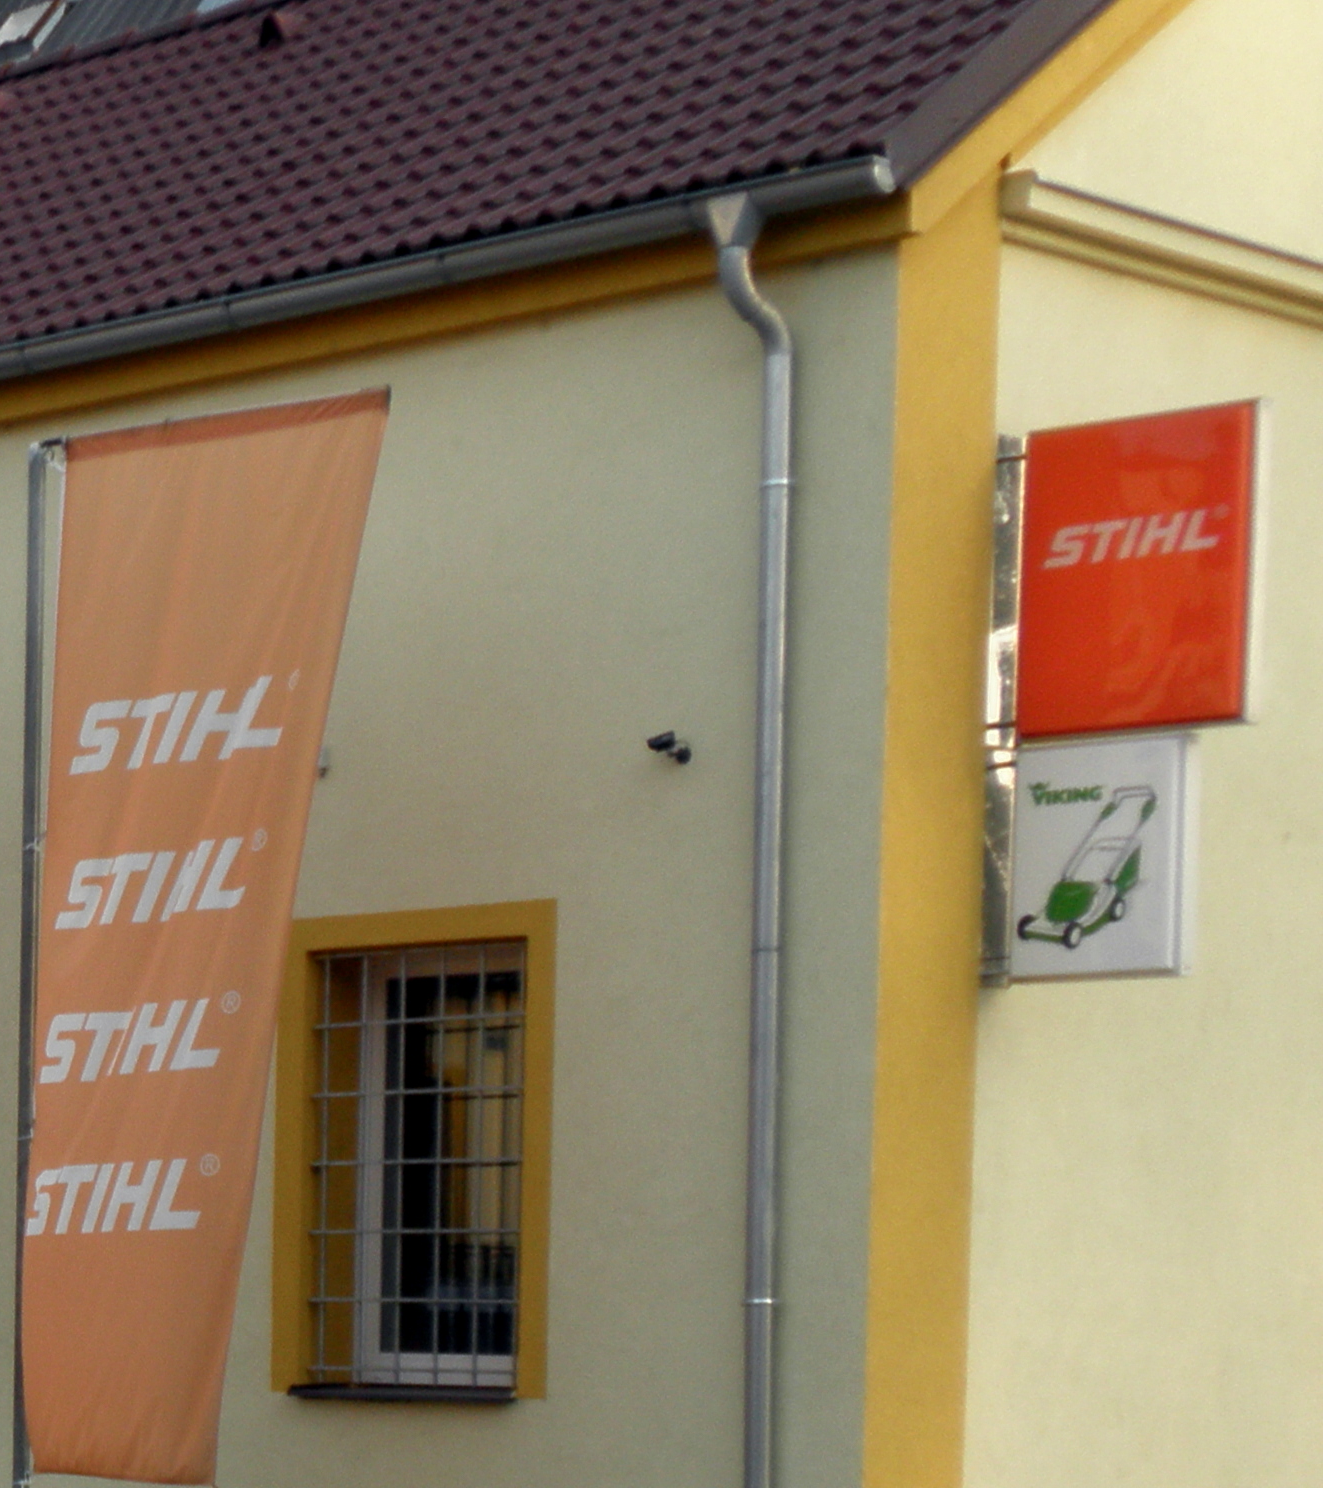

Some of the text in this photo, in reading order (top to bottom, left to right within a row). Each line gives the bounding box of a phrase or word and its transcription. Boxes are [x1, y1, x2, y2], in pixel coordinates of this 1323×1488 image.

[1043, 508, 1221, 569] STIHL
[69, 675, 283, 776] STIHL
[1029, 784, 1102, 806] VIKING
[55, 836, 246, 930] STIHL
[25, 1158, 201, 1237] STIHL
